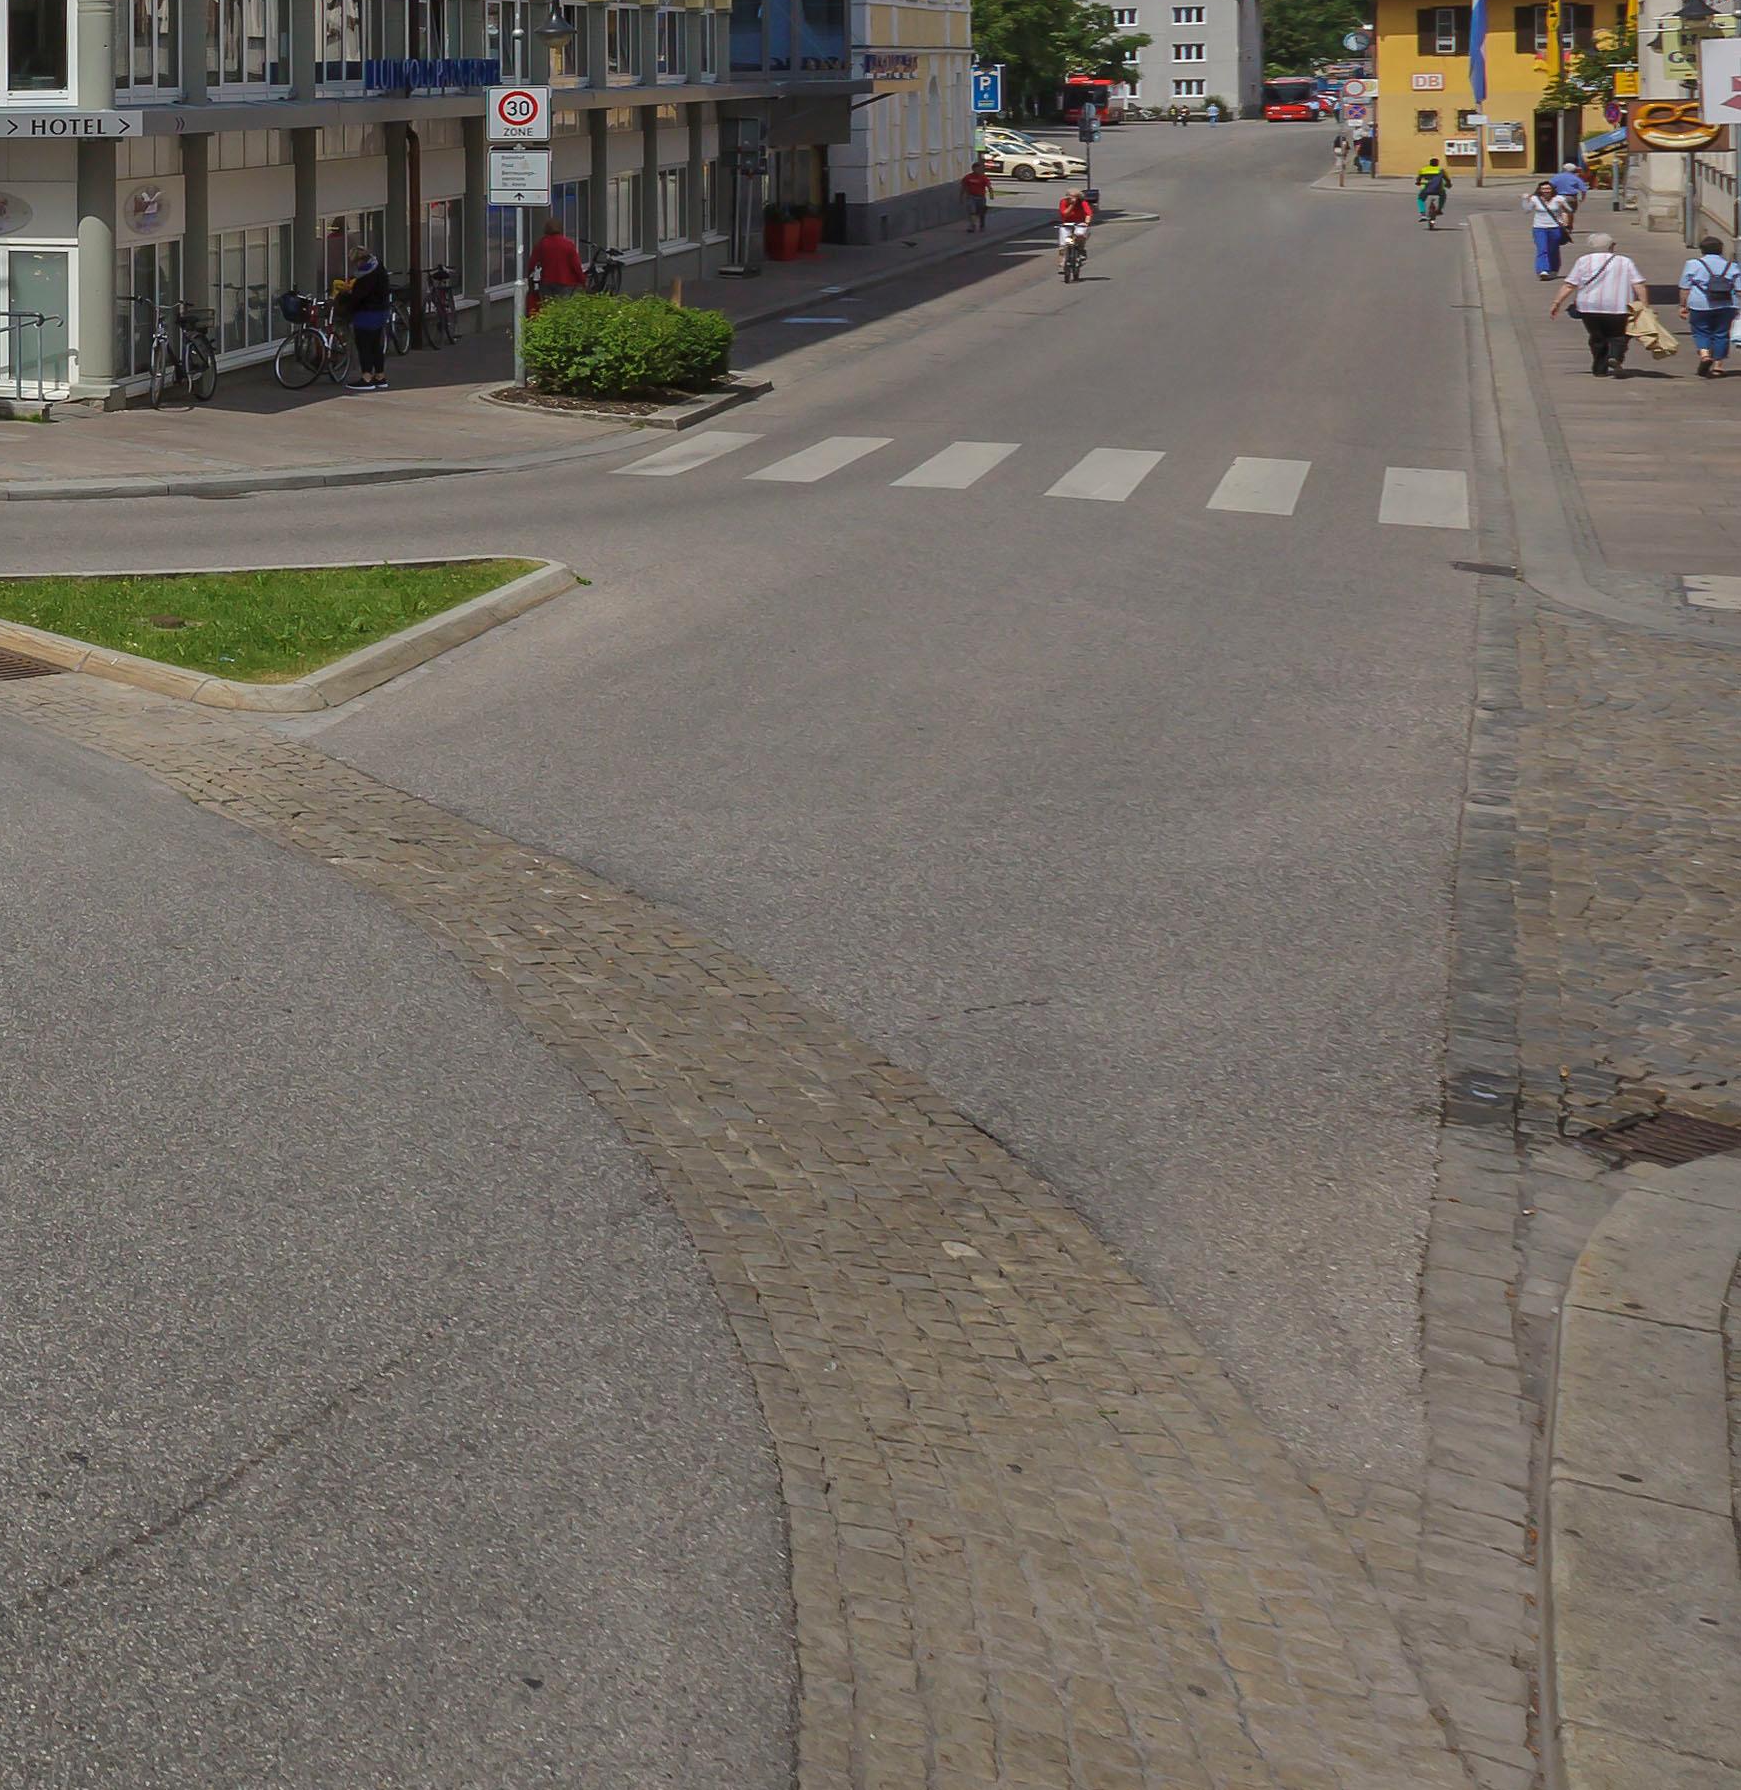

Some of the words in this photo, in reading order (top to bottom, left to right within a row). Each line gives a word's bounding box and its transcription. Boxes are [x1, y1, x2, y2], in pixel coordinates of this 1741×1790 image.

[980, 77, 991, 90] P
[1414, 75, 1440, 87] DB
[506, 100, 529, 116] 30
[31, 119, 107, 135] HOTEL
[503, 128, 534, 136] ZONE
